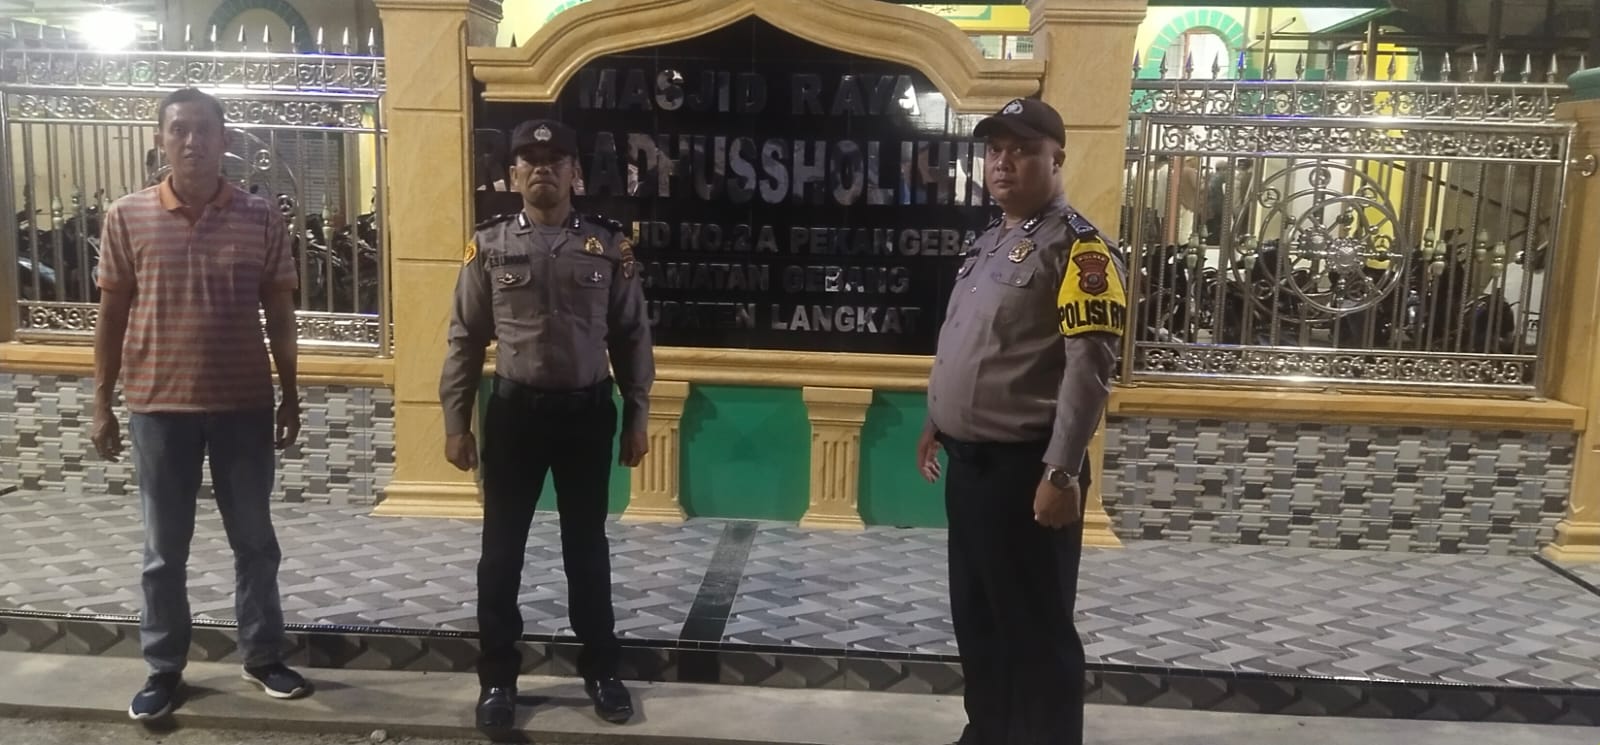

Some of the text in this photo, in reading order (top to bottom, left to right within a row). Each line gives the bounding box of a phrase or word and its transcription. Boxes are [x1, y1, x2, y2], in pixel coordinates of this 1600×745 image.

[578, 68, 921, 116] MASJID RAYA
[627, 220, 671, 249] JID
[790, 227, 896, 257] PEKAN
[900, 229, 978, 257] GEBA
[783, 265, 911, 294] GEBANG
[643, 300, 921, 334] UPATEN LANGKAT
[1058, 299, 1109, 334] POLISI
